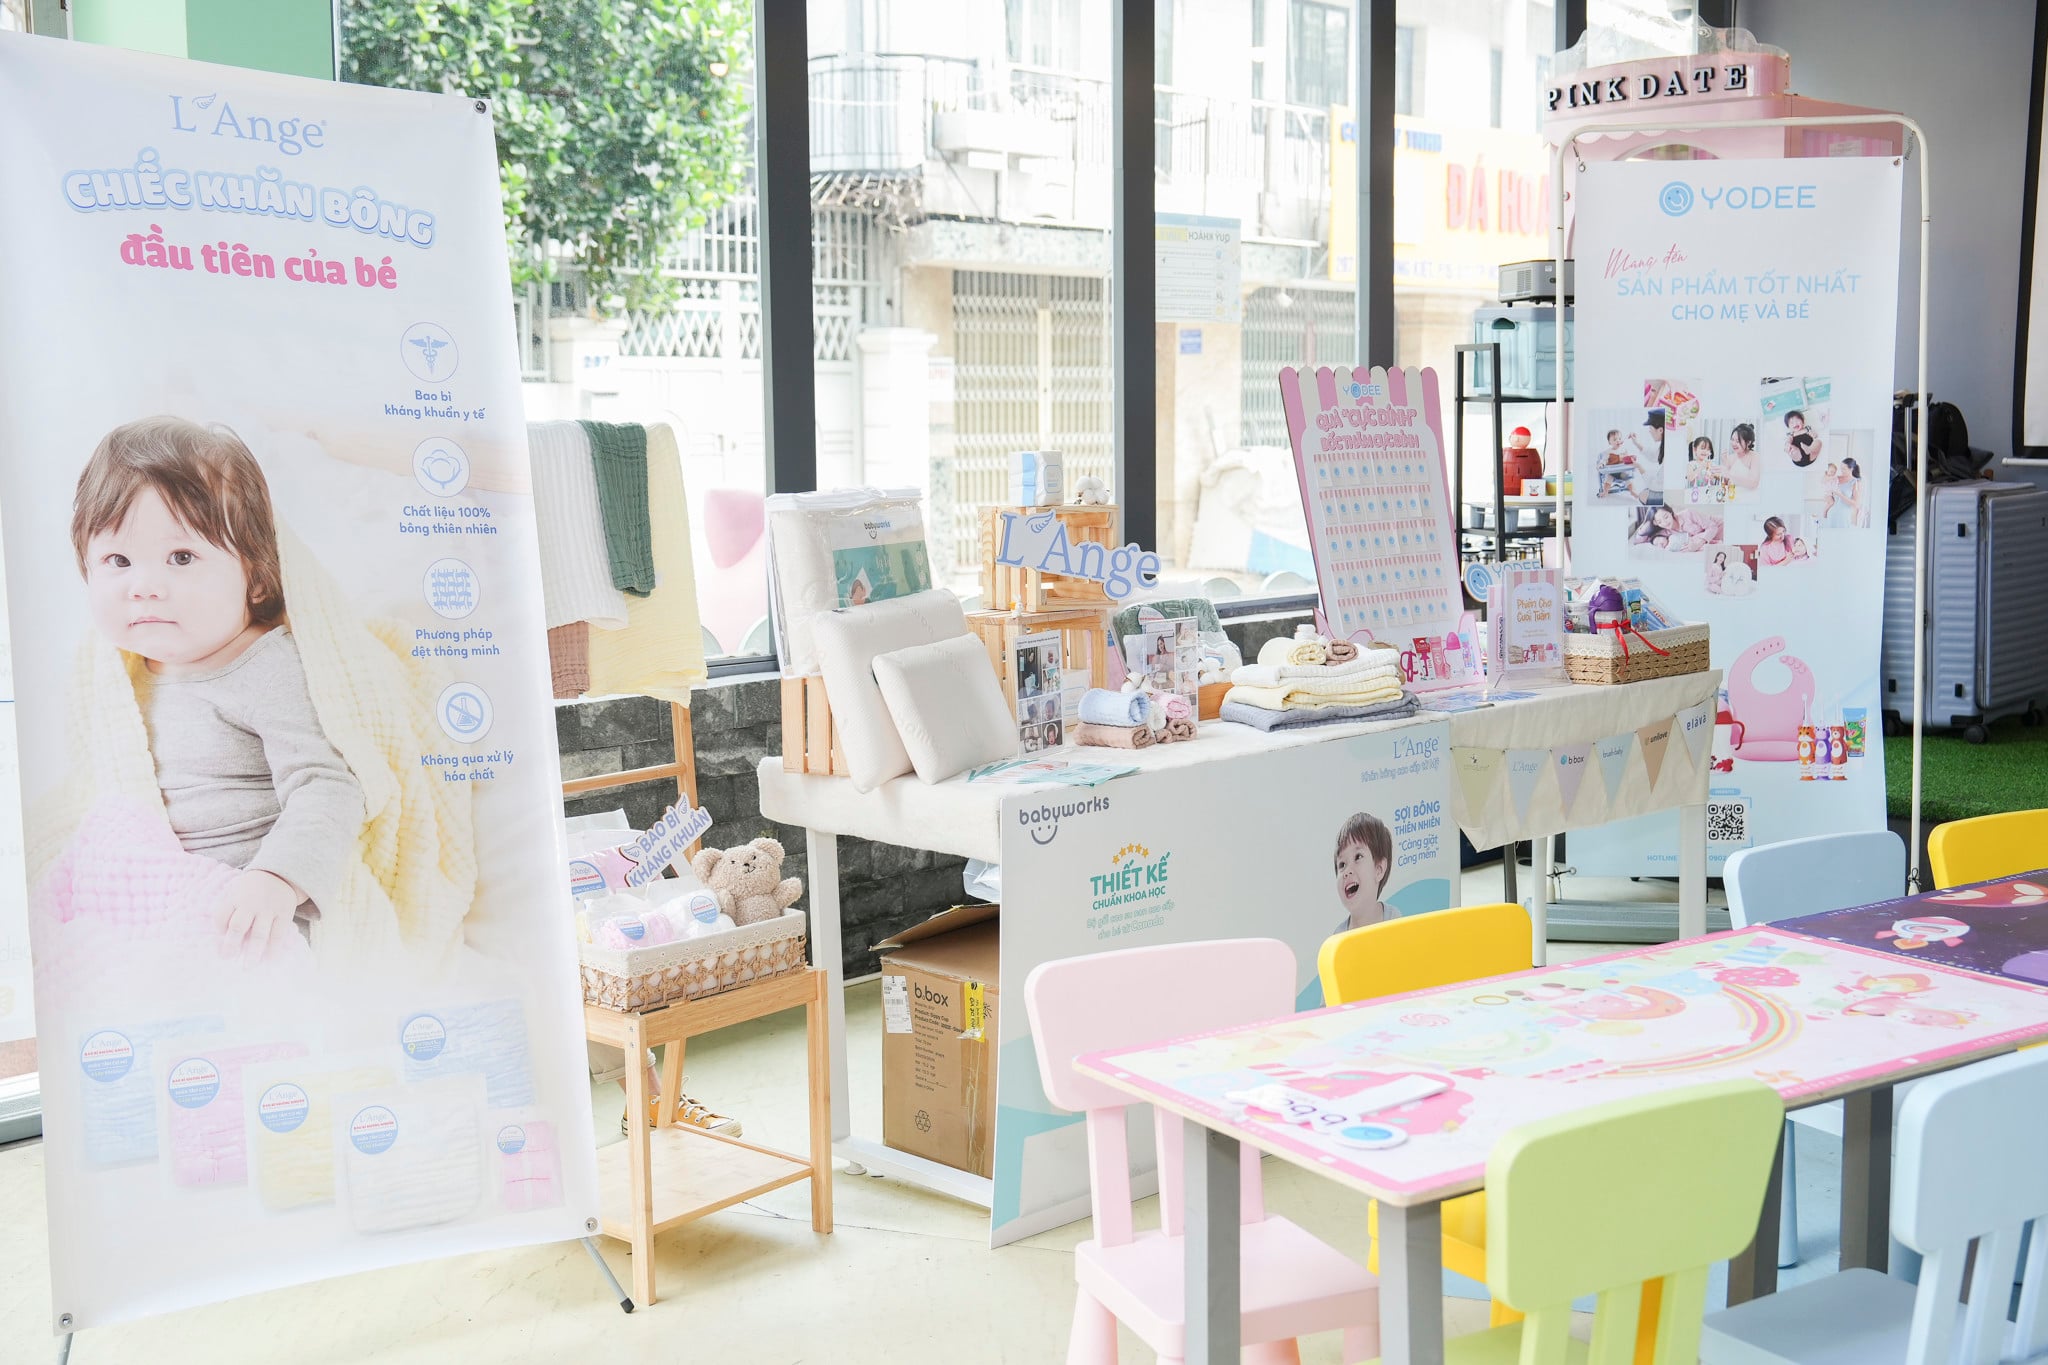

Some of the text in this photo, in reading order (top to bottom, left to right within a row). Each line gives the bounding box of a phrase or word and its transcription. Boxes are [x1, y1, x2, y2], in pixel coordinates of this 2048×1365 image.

[1546, 64, 1747, 111] PINK DATE
[168, 93, 326, 156] L'Ange
[196, 166, 315, 222] KHĂN
[321, 186, 438, 249] BÔNG
[1701, 185, 1817, 210] YODEE
[120, 223, 397, 289] đầu tiên của bé
[1604, 243, 1688, 280] Mang đến
[1617, 268, 1861, 296] SẢN PHẨM TỐT NHẤT
[1672, 299, 1809, 323] CHO MẸ VÀ BÉ
[415, 390, 452, 401] Bao bì
[384, 404, 485, 421] kháng khuẩn y tế
[403, 504, 491, 520] Chất liệu 100%
[399, 522, 497, 536] bông thiên nhiên
[997, 510, 1160, 598] L'Ange
[415, 628, 493, 642] Phương pháp
[411, 645, 500, 659] dệt thông minh
[421, 751, 514, 768] Không qua xử lý
[1394, 736, 1439, 759] L'Ange
[444, 767, 495, 782] hóa chất
[1019, 796, 1110, 825] babyworks
[1394, 800, 1440, 823] SỢI BÔNG
[640, 807, 681, 853] BAO BÌ
[1394, 816, 1440, 836] THIÊN NHIÊN
[629, 810, 710, 887] KHÁNG KHUẨN
[1423, 835, 1438, 848] giặt
[1397, 854, 1417, 867] Càng
[1090, 851, 1171, 897] THIẾT KẾ
[1092, 885, 1166, 910] CHUẨN KHOA HỌC
[1131, 916, 1164, 932] Canada
[914, 982, 949, 1007] b.box
